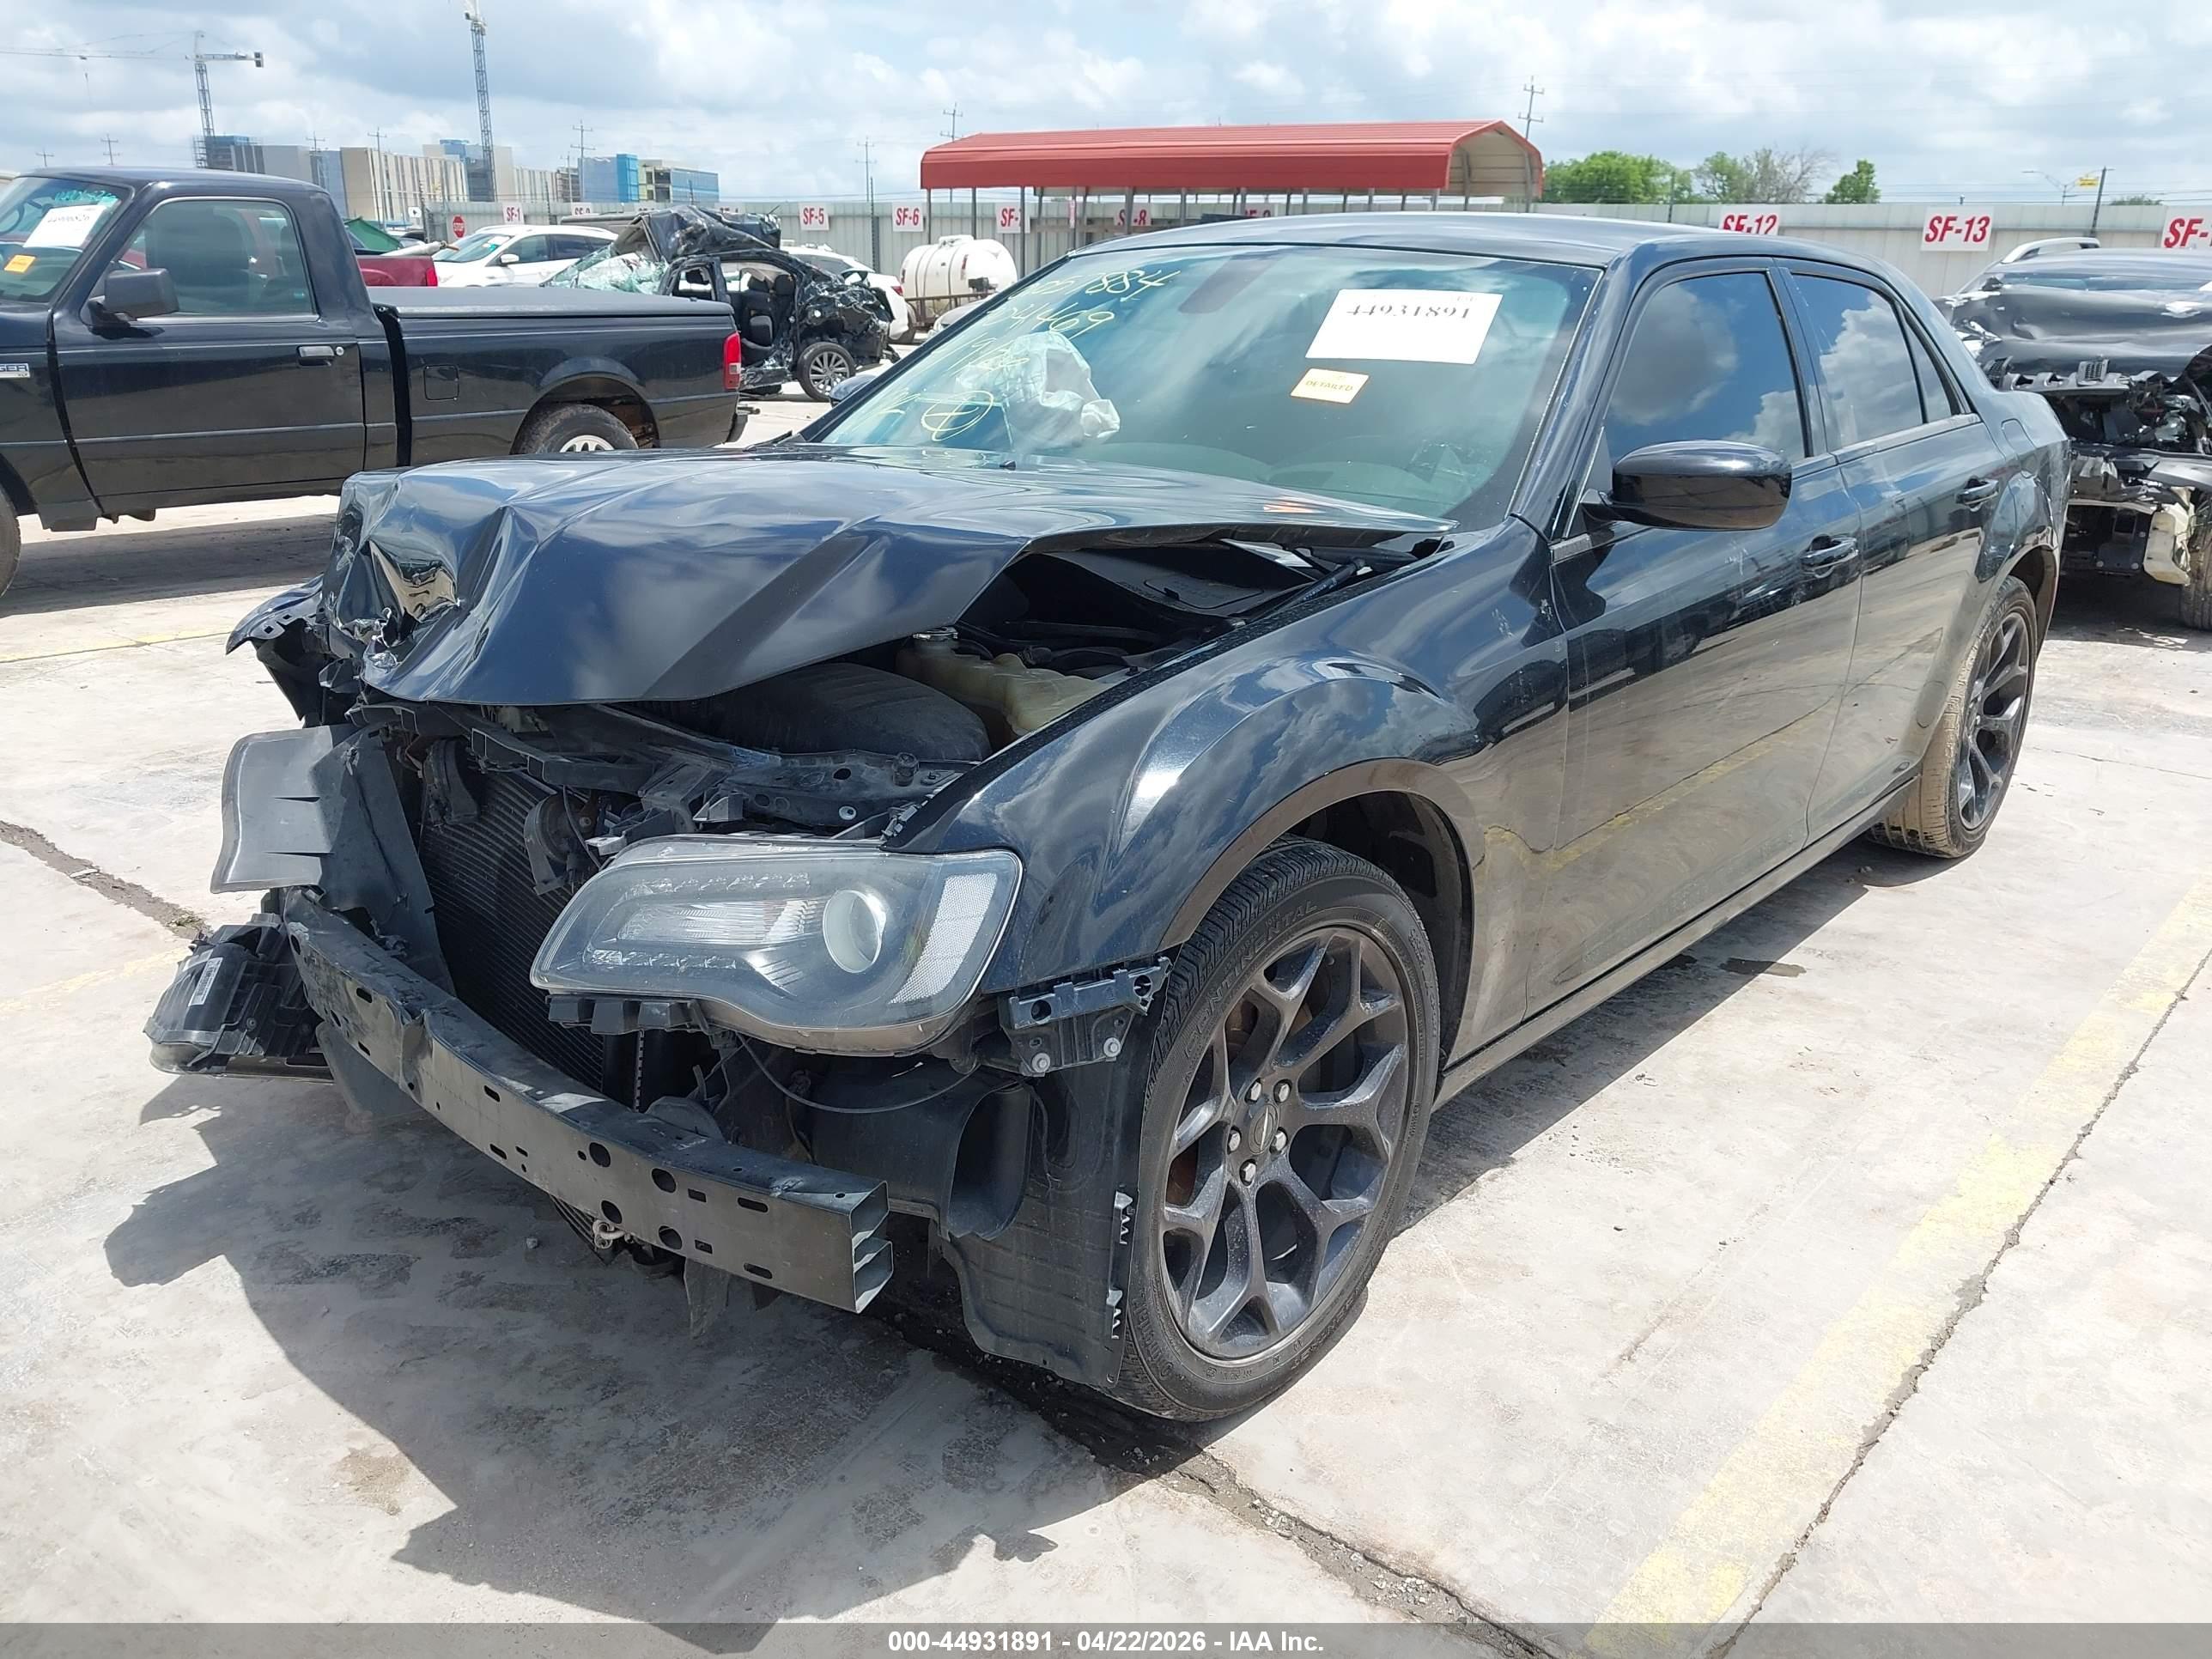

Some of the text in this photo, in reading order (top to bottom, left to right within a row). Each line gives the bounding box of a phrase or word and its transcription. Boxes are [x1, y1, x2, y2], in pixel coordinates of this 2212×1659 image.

[506, 206, 521, 222] SF-1
[802, 207, 825, 226] SF-5
[896, 207, 921, 226] SF-6
[1000, 207, 1022, 228] SF-
[1117, 208, 1147, 227] S-8
[1924, 215, 1990, 243] SF-13
[2163, 217, 2212, 249] SF-
[1346, 304, 1470, 319] 44931891
